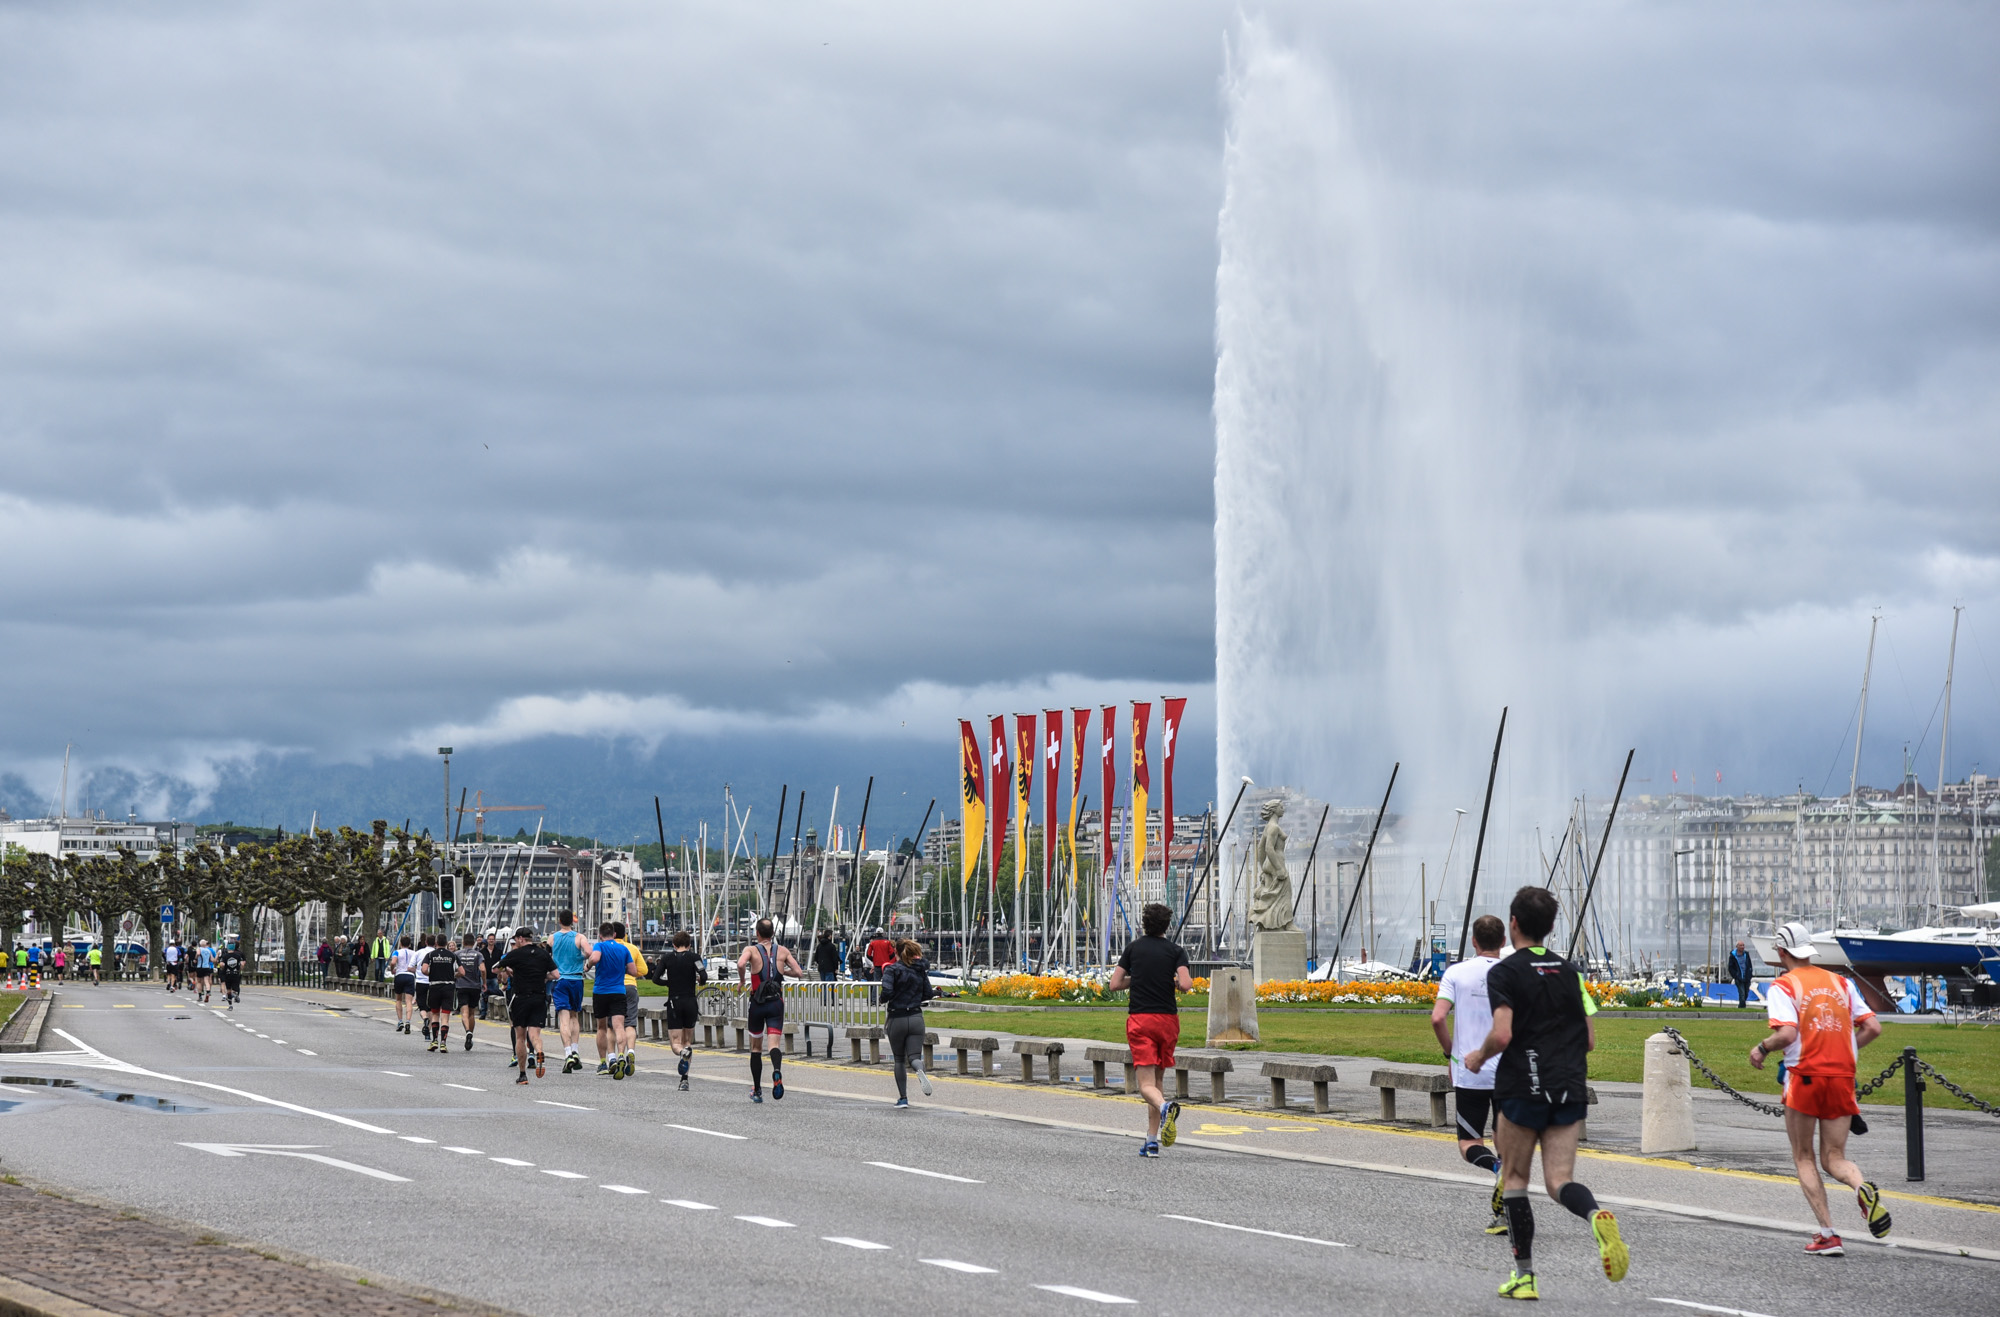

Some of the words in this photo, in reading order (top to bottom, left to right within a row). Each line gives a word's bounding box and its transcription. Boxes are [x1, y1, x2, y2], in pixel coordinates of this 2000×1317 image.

[1681, 809, 1711, 818] RICHARD
[1712, 808, 1734, 817] MILLE
[1525, 1049, 1541, 1095] Kalenji
